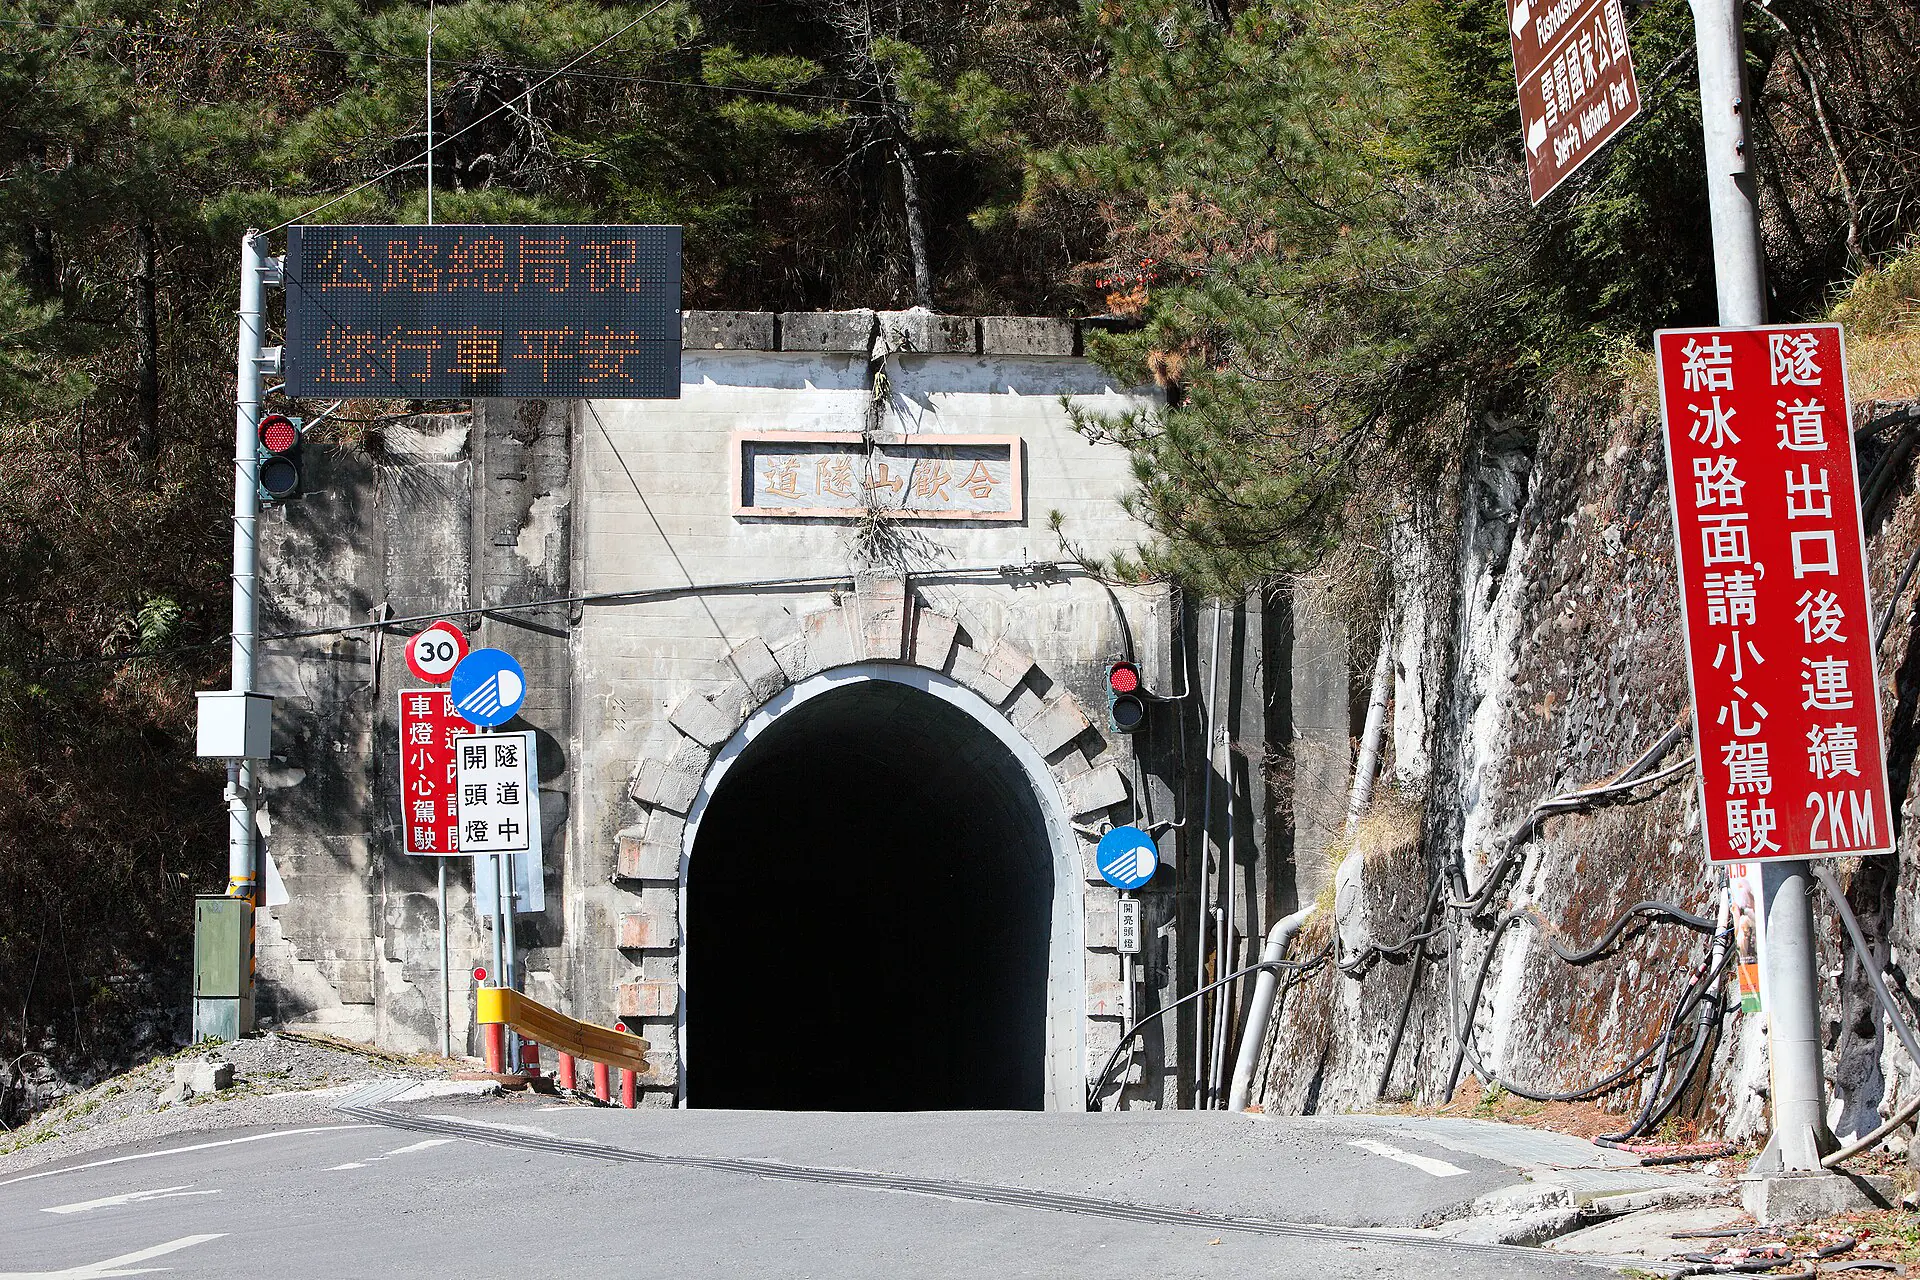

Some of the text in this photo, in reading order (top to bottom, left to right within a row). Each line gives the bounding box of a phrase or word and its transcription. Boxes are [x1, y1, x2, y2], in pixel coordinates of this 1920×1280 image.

[1541, 1, 1627, 128] 雪霸國家公園
[1553, 74, 1632, 169] Shei-Pa National Park
[317, 235, 641, 293] 公路總局祝
[315, 325, 640, 382] 您行車平安
[419, 641, 454, 662] 30
[408, 694, 438, 851] 車燈小心駕駛
[463, 744, 489, 844] 開頭燈
[494, 744, 520, 843] 隧道中
[1123, 903, 1134, 949] 開亮頭燈
